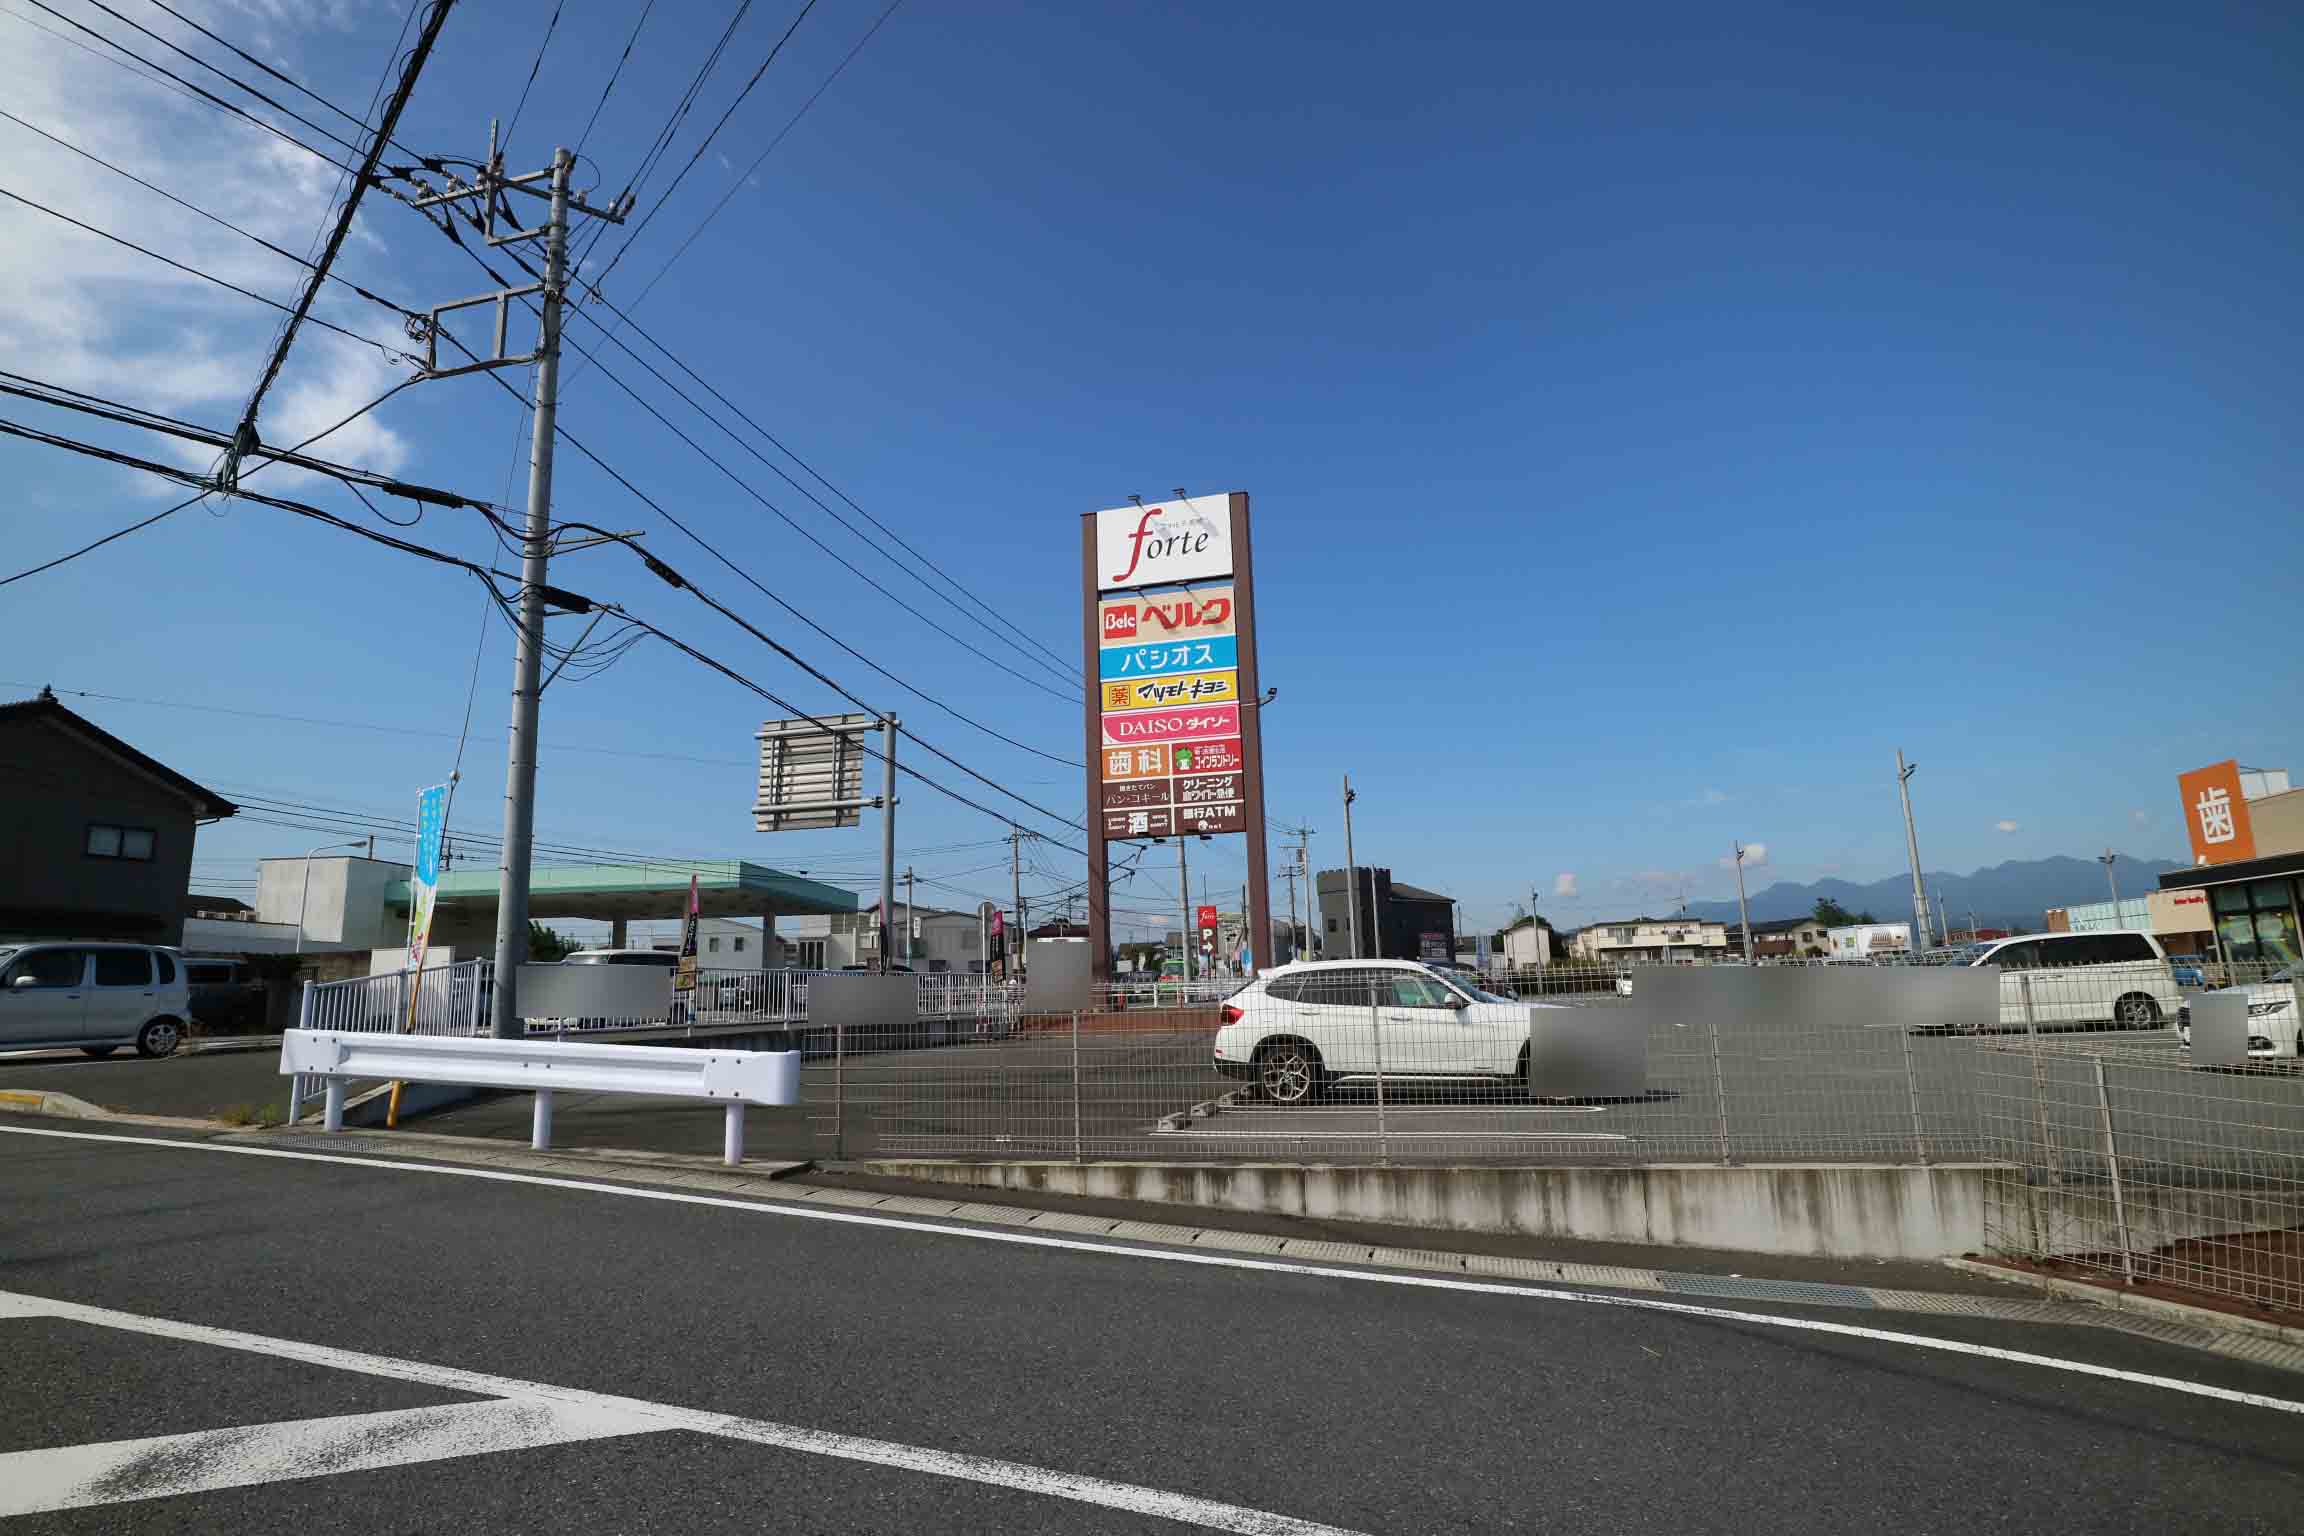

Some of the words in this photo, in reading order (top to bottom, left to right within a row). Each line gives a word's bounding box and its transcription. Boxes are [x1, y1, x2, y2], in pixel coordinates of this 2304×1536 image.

[1112, 508, 1209, 582] forte
[1105, 613, 1136, 630] Belc
[1141, 598, 1231, 632] ベルク
[1121, 644, 1213, 672] パシオス
[1112, 688, 1130, 705] 薬
[1119, 718, 1184, 736] DAISO
[1185, 715, 1231, 730] ダイソー
[1183, 776, 1233, 790] クリーニング
[1128, 812, 1149, 833] 酒
[2195, 787, 2236, 845] 歯
[1203, 929, 1213, 940] P
